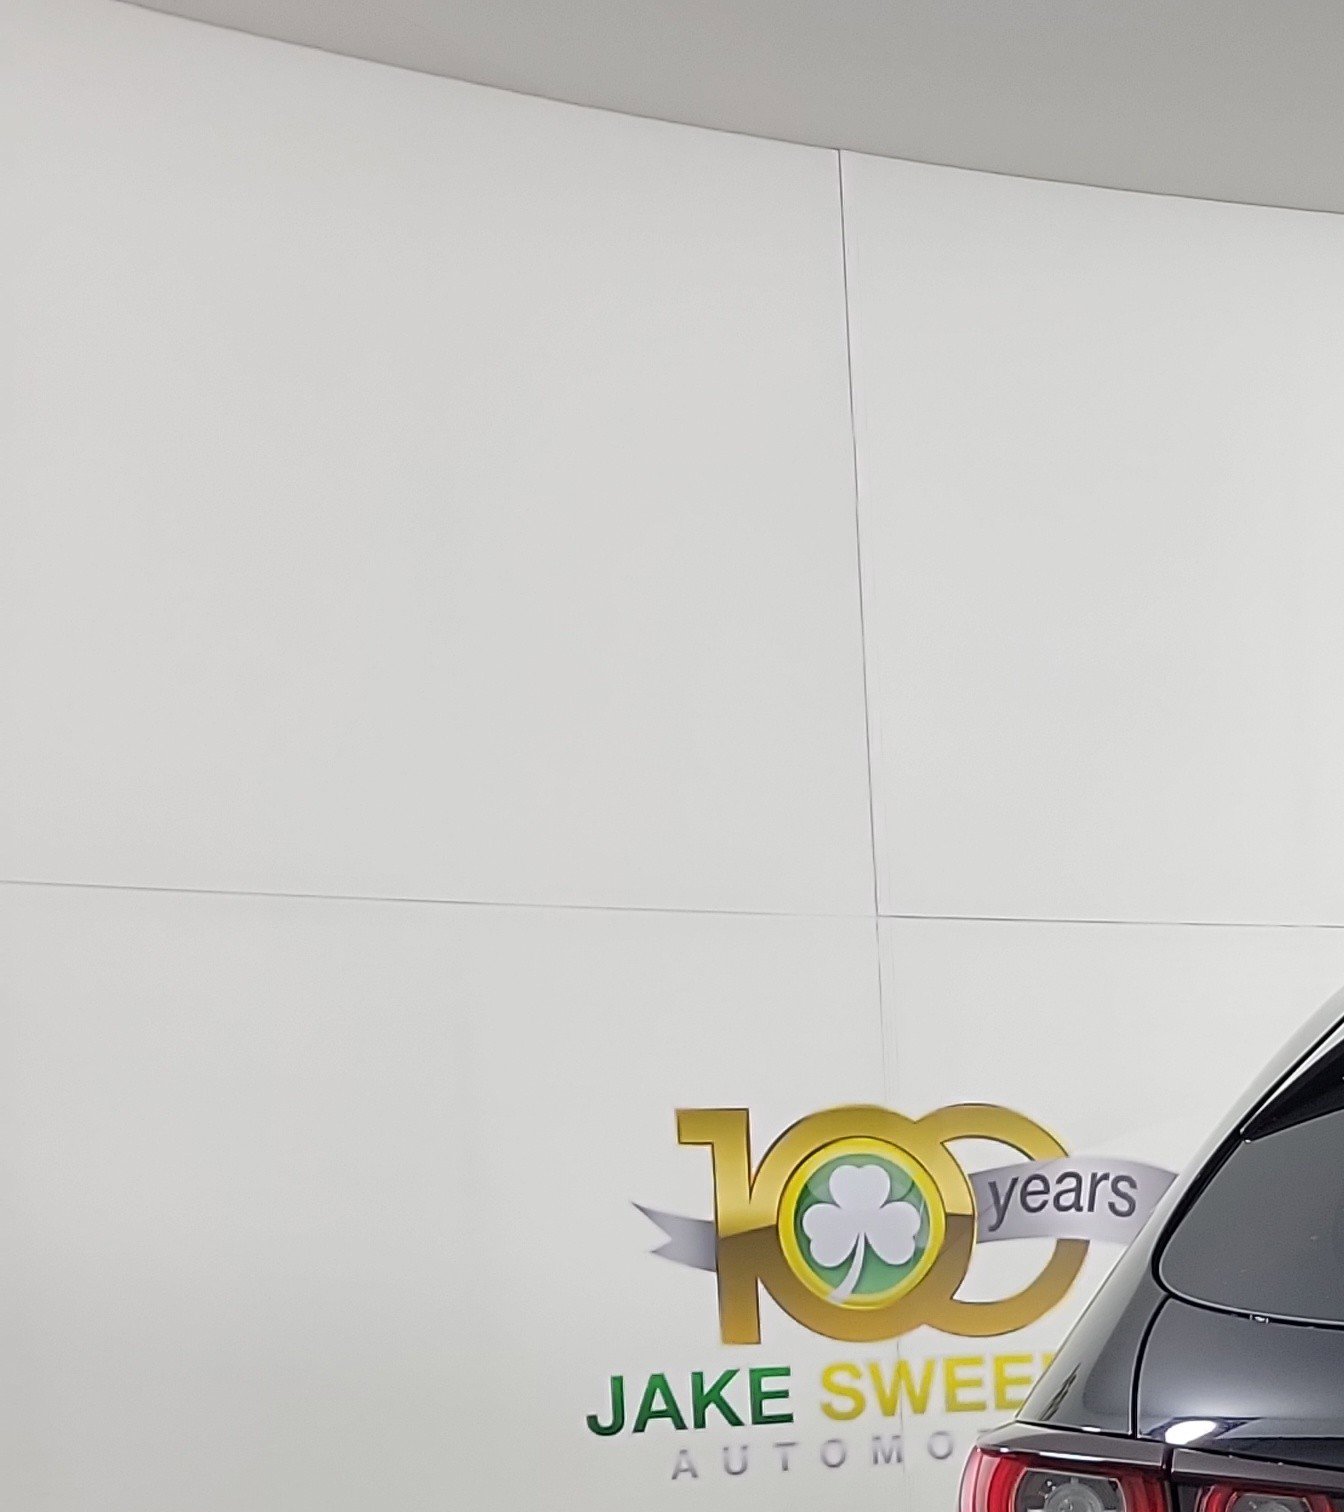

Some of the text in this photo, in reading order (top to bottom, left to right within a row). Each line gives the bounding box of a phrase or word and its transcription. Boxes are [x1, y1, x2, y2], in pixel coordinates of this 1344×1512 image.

[674, 1102, 1138, 1345] 100 years
[585, 1353, 1055, 1437] JAKE SWEE
[671, 1428, 991, 1481] AUTOMO
